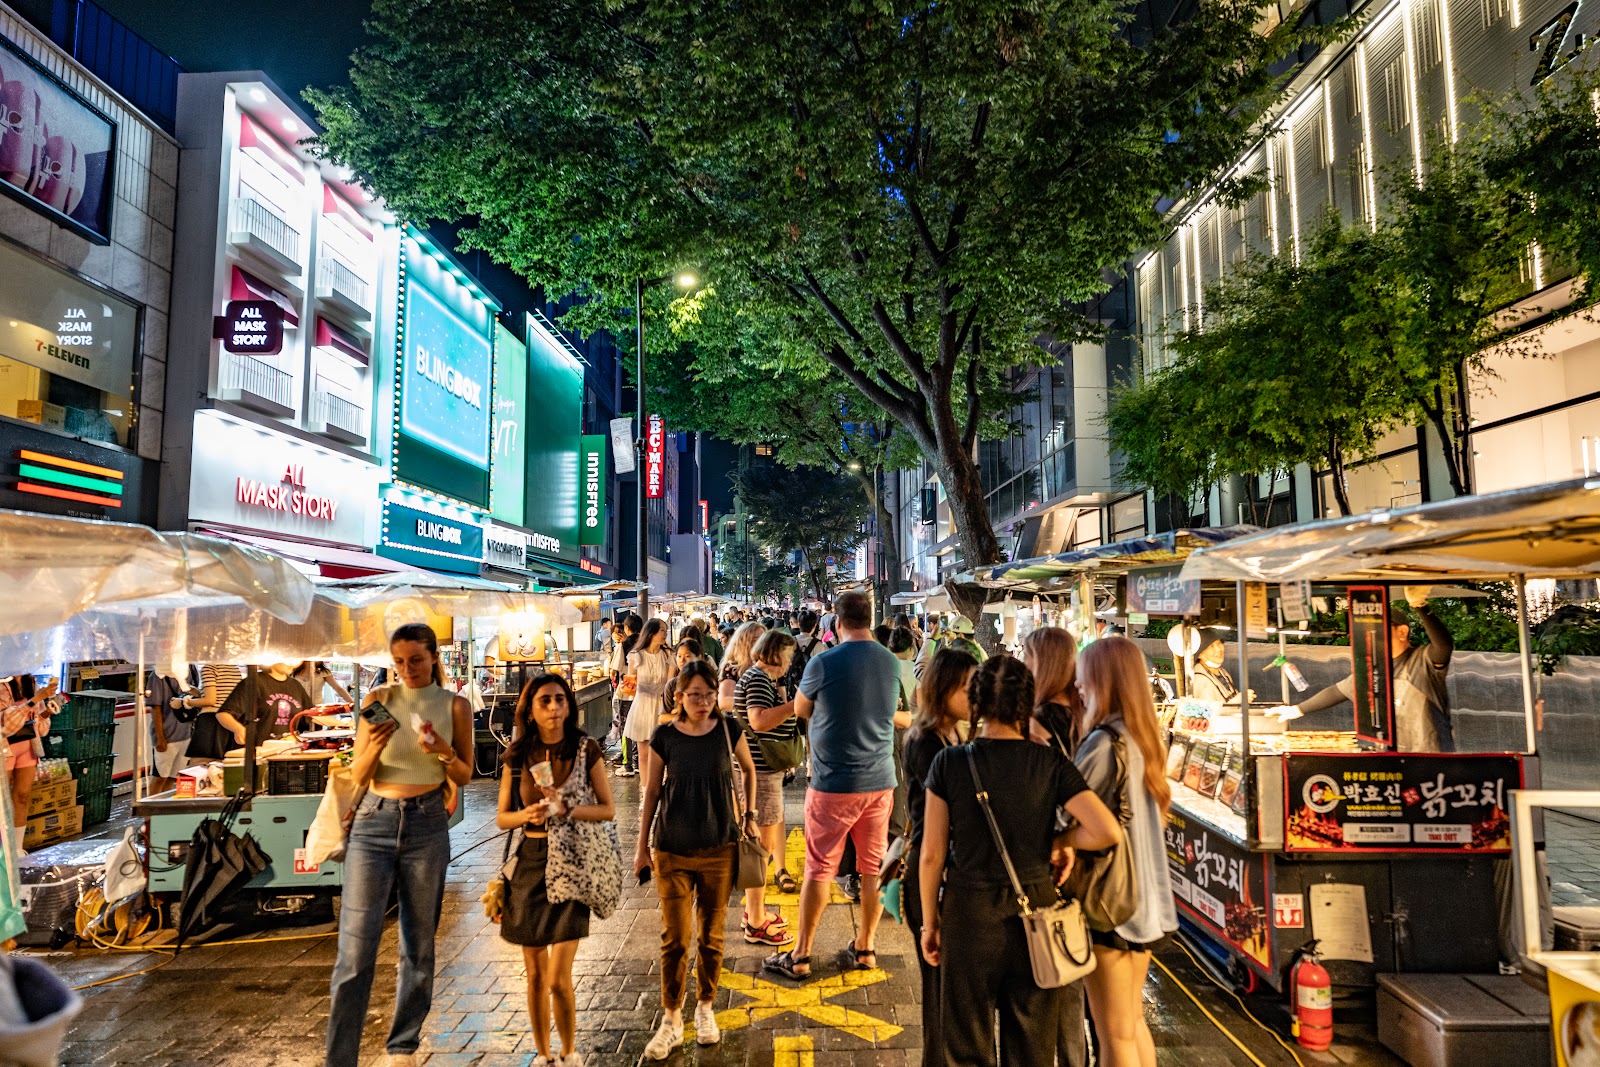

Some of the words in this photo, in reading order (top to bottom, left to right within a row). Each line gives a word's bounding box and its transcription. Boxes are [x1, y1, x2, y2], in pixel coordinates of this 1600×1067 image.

[241, 307, 262, 318] ALL
[234, 321, 267, 332] MASK
[232, 335, 268, 346] STORY
[416, 344, 482, 412] BLINGBOX
[281, 463, 306, 488] ALL
[237, 476, 289, 512] MASK
[291, 489, 340, 521] STORY
[416, 519, 462, 545] BLINGBOX
[1343, 783, 1402, 805] 박효신
[1420, 773, 1504, 819] 닭꼬치
[1443, 833, 1458, 841] OUT
[1194, 831, 1244, 904] 닭꼬치
[1276, 897, 1298, 906] 소화기
